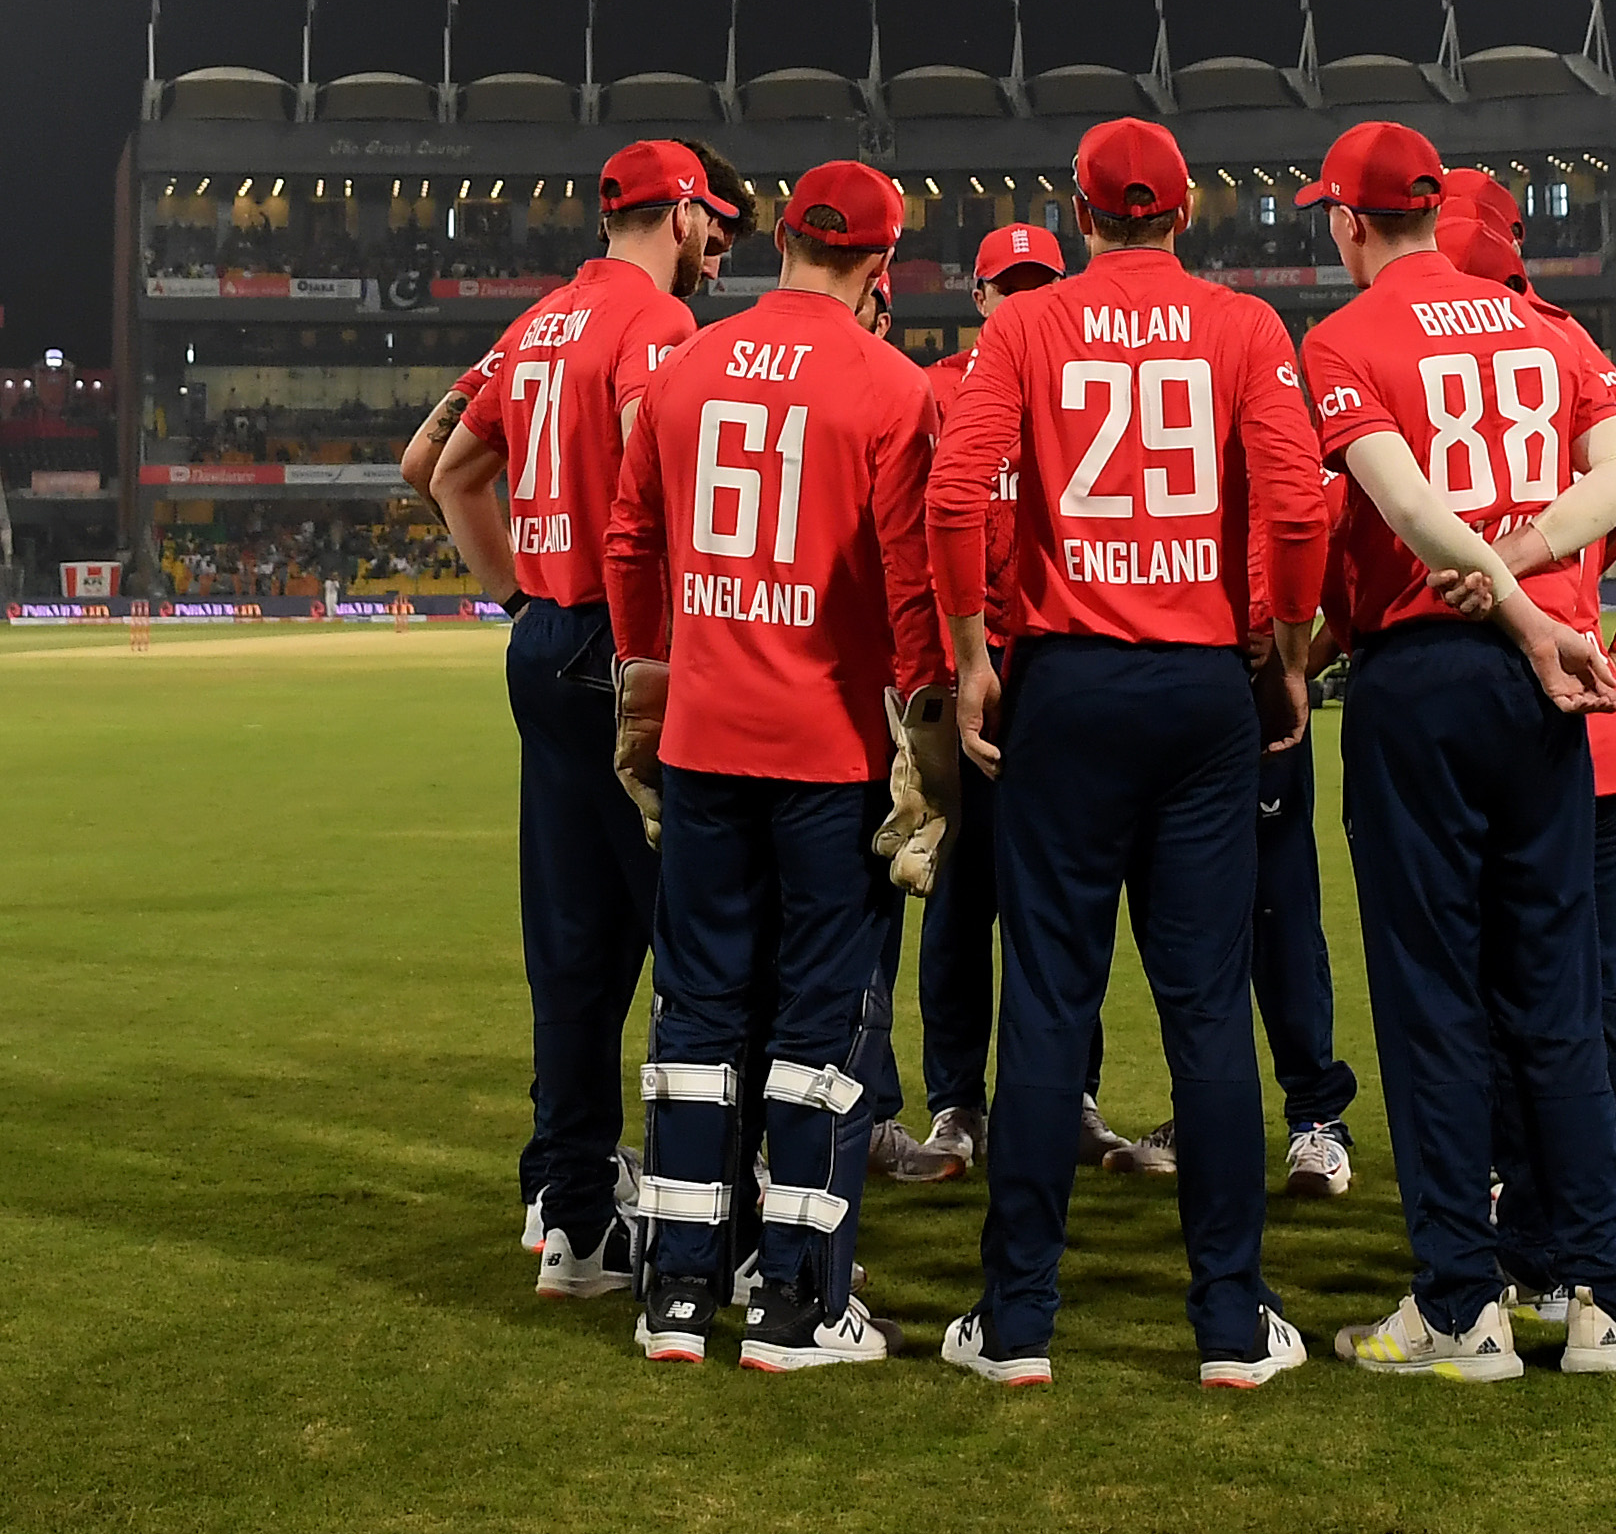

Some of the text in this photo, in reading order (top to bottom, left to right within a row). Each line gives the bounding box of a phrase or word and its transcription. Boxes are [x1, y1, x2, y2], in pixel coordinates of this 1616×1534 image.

[1083, 305, 1191, 349] MALAN
[1411, 296, 1526, 337] BROOK
[725, 339, 813, 382] SALT
[511, 359, 565, 500] 71
[1059, 358, 1219, 518] 29
[1418, 347, 1560, 513] 88
[692, 399, 809, 564] 61
[1063, 538, 1219, 584] ENGLAND
[683, 572, 816, 627] ENGLAND
